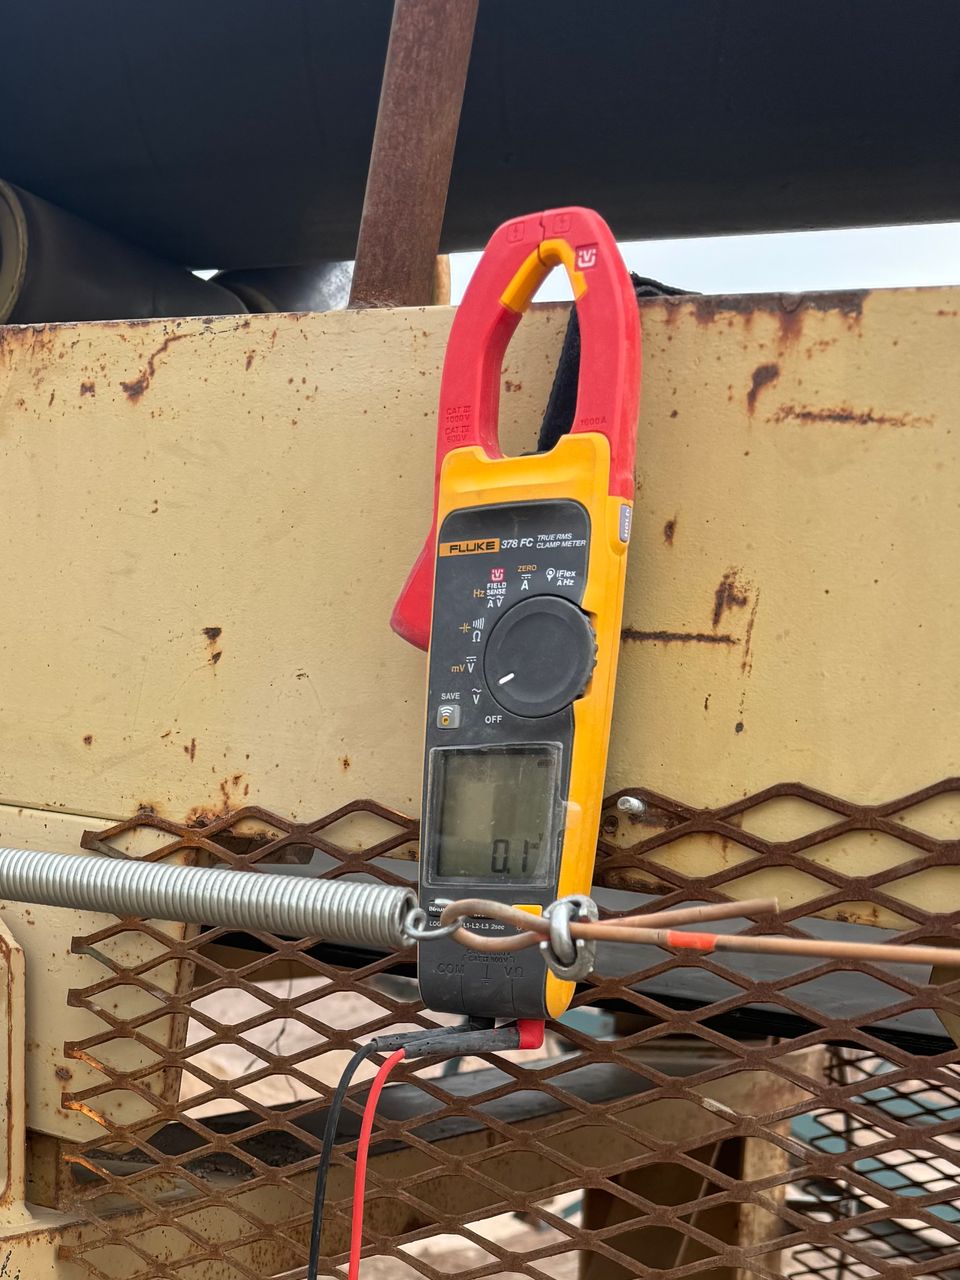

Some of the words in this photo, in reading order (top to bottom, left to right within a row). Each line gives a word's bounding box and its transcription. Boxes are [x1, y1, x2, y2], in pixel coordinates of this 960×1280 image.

[449, 541, 496, 554] FLUKE
[501, 539, 518, 549] 378
[520, 538, 534, 547] FC
[536, 541, 561, 549] CLAMP
[473, 589, 485, 598] Hz
[451, 664, 466, 673] mV
[441, 692, 460, 700] SAVE
[484, 715, 502, 723] OFF
[491, 839, 529, 874] 0.1
[437, 963, 465, 975] COM
